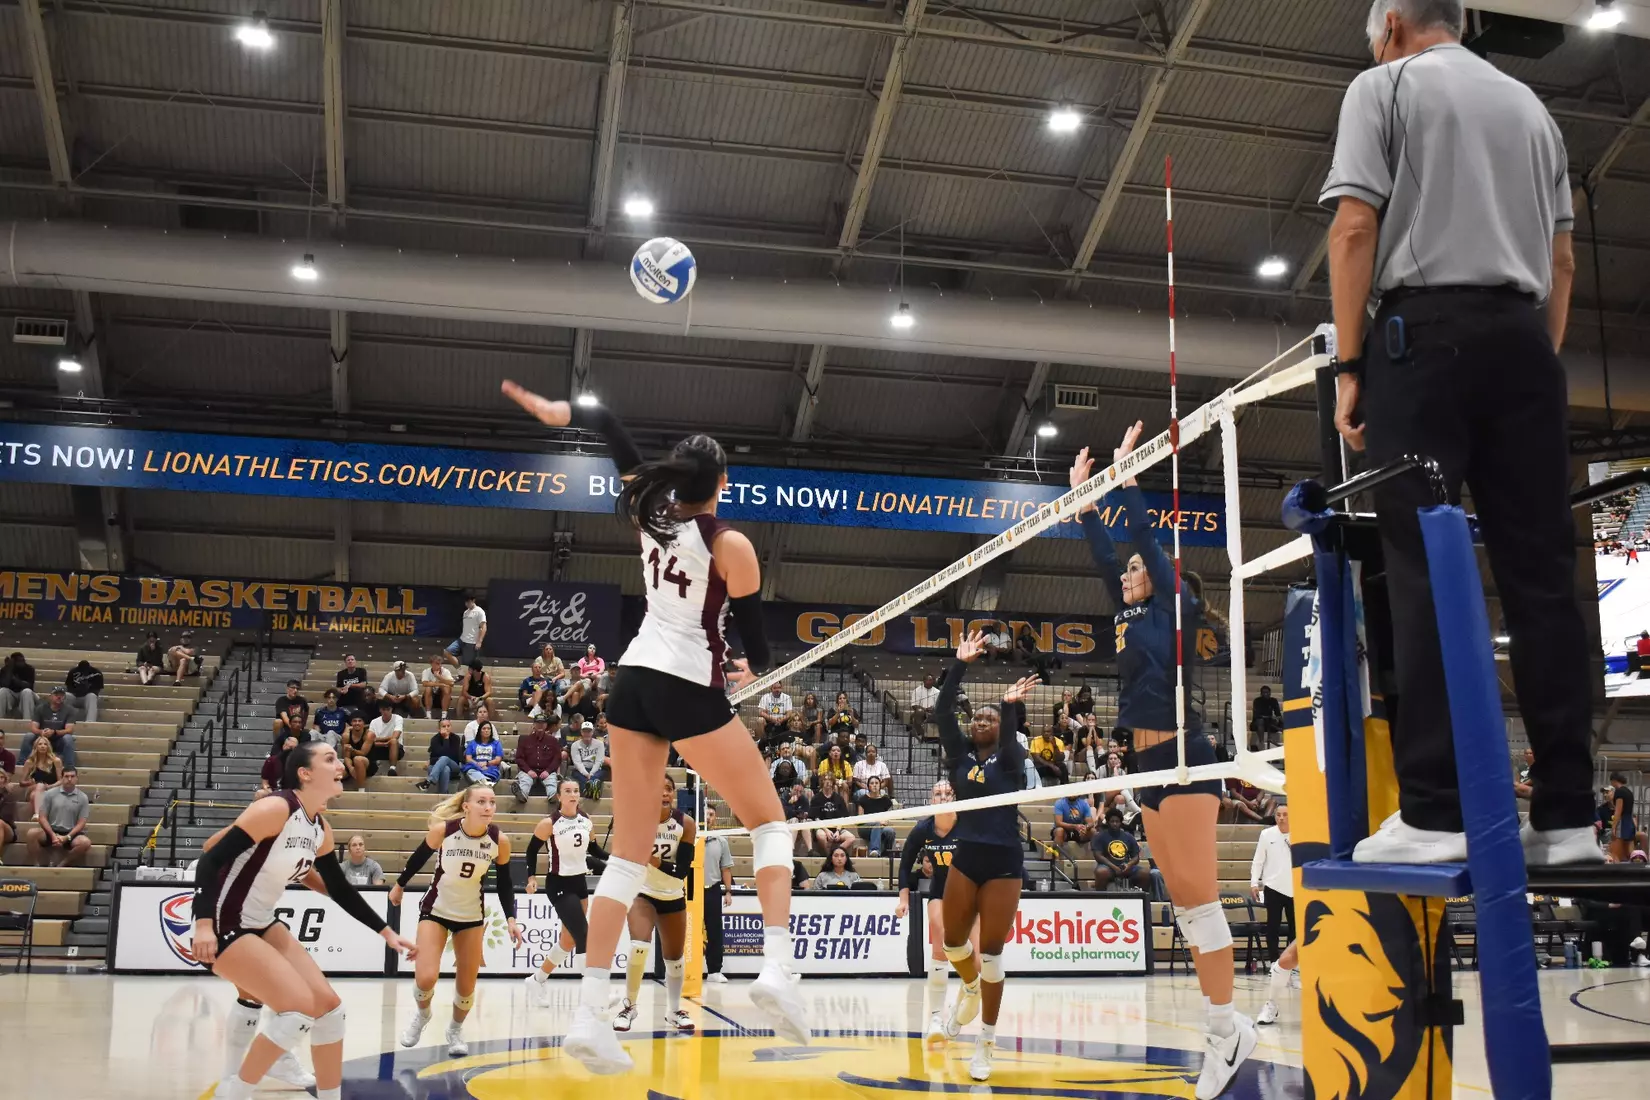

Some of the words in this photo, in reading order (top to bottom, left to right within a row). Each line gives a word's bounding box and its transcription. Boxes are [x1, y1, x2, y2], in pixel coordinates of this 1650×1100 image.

[643, 257, 672, 287] molten
[0, 441, 41, 466] TS
[52, 444, 134, 470] NOW!
[143, 449, 568, 495] LIONATHLETICS.COM/TICKETS
[777, 486, 848, 511] NOW!
[648, 547, 692, 598] 14
[139, 576, 427, 616] BASKETBALL
[518, 589, 561, 619] Fix
[560, 592, 587, 625] &
[57, 604, 66, 621] 7
[72, 605, 112, 623] NCAA
[119, 606, 231, 628] TOURNAMENTS
[292, 614, 415, 635] ALL-AMERICANS
[528, 615, 591, 645] Feed
[796, 611, 885, 647] GO
[445, 848, 473, 857] SOUTHERN
[573, 832, 583, 848] 3
[651, 843, 672, 860] 22
[288, 857, 313, 884] 12
[459, 861, 476, 879] 9
[514, 899, 560, 919] Hun
[722, 915, 764, 930] Hilto
[514, 922, 562, 951] Regi
[788, 914, 835, 936] BEST
[839, 914, 901, 936] PLACE
[814, 938, 871, 959] STAY!
